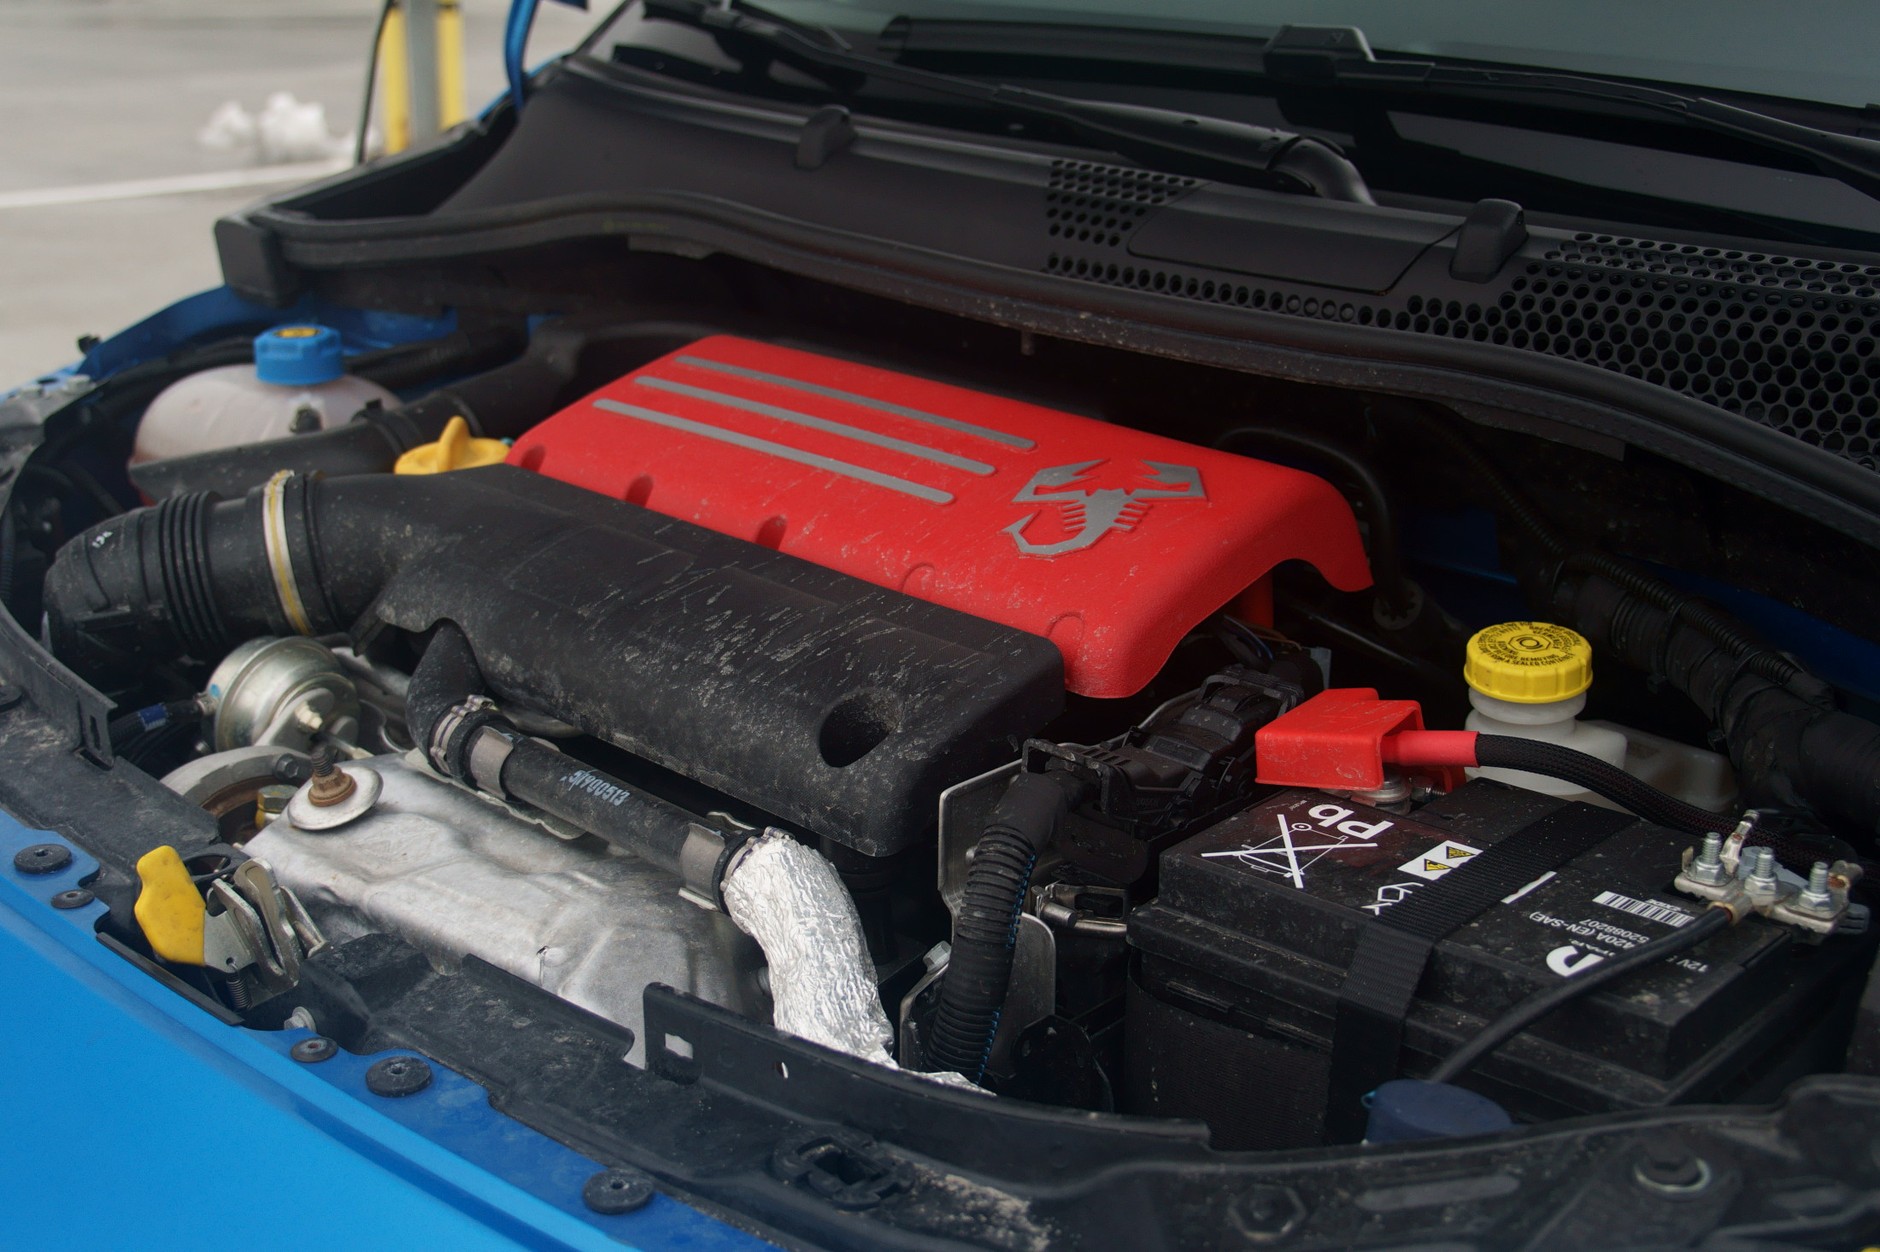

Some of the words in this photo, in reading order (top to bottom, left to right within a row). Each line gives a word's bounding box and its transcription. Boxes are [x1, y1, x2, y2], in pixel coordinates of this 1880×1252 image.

[1308, 804, 1395, 840] Pb
[1529, 911, 1598, 937] (EN-SAE)
[1579, 918, 1650, 944] 52088207
[1596, 932, 1636, 950] 420A
